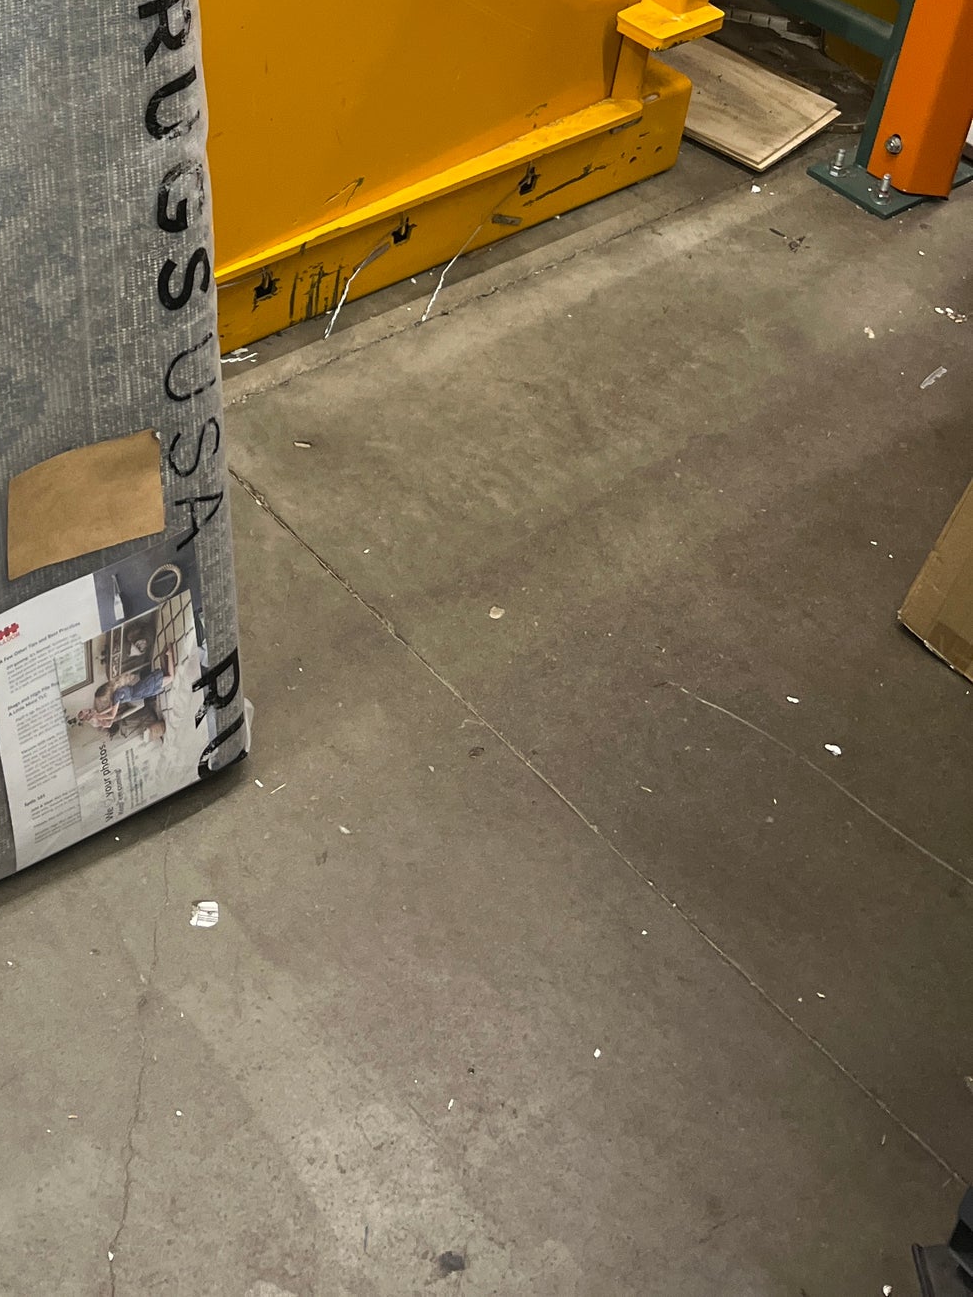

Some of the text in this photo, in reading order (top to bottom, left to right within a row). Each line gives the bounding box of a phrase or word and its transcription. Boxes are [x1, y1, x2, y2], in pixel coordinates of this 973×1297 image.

[4, 654, 13, 662] Few
[47, 630, 58, 639] Best
[104, 778, 115, 799] your
[105, 806, 114, 823] We
